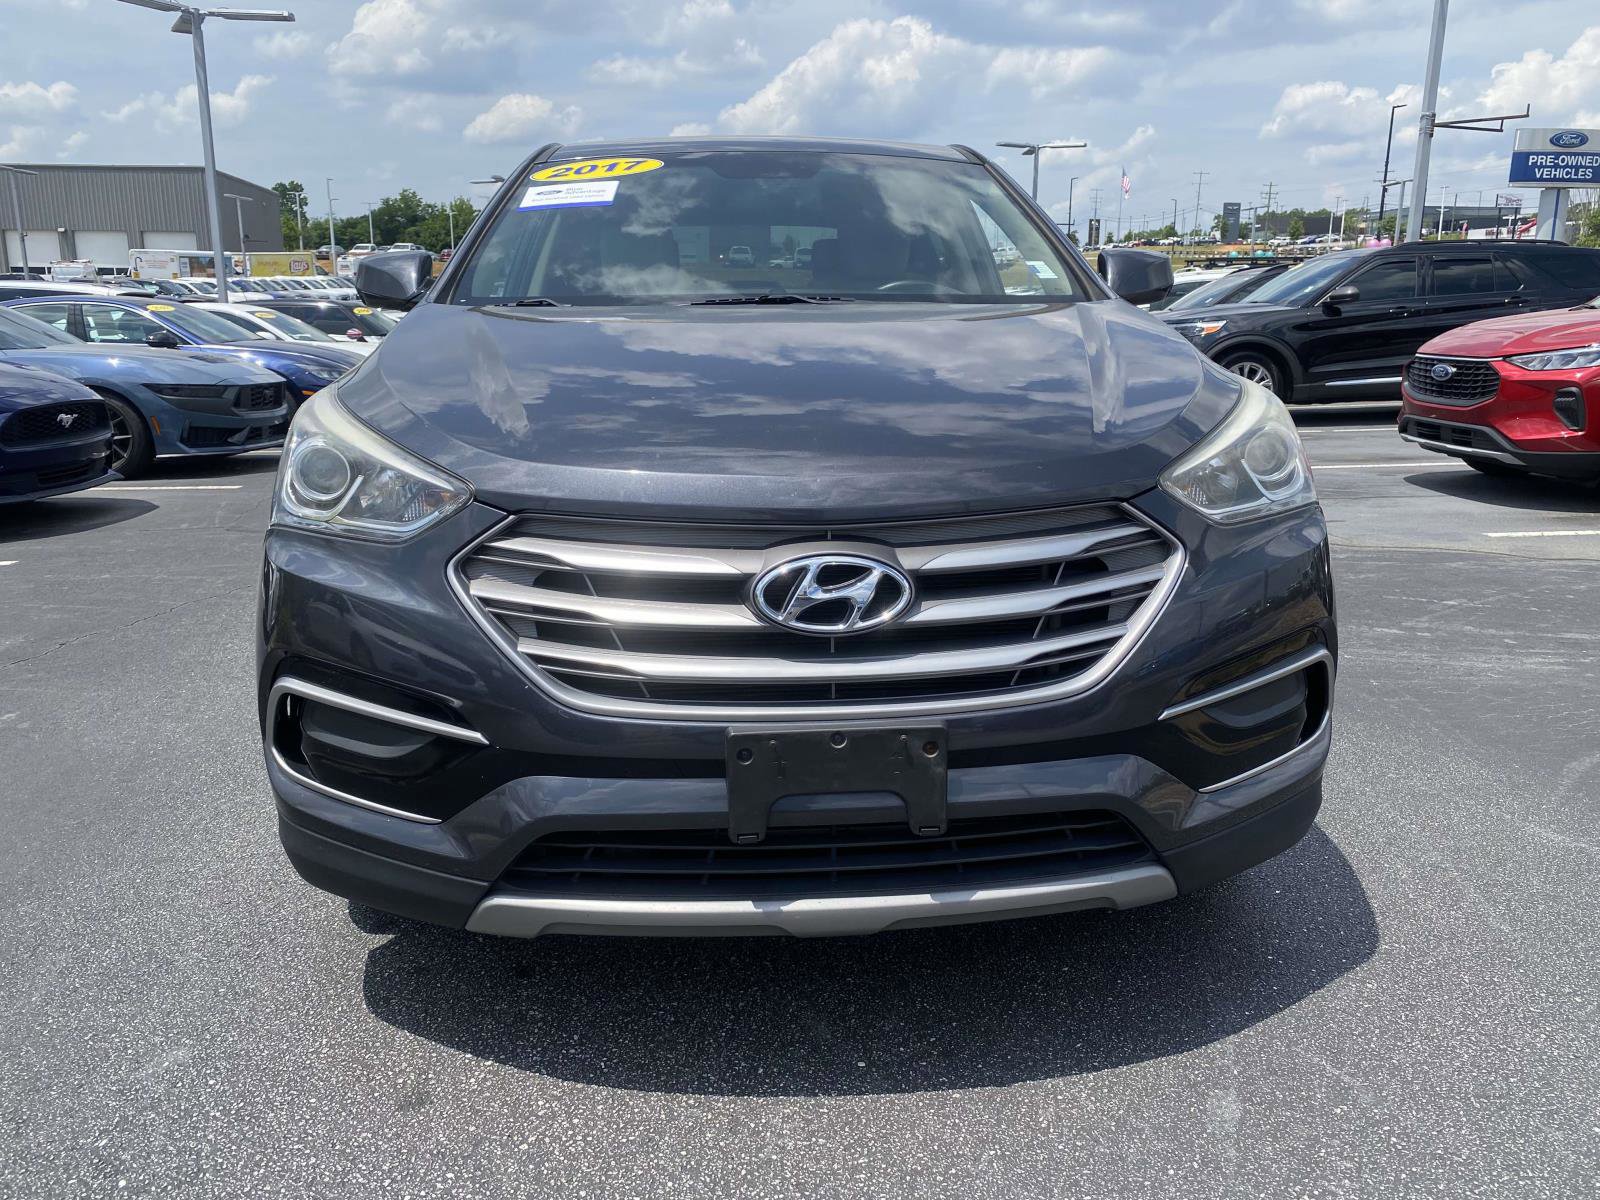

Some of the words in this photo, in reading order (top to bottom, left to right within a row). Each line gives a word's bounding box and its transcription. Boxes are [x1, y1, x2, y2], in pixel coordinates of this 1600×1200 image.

[1559, 134, 1582, 144] Ford
[1528, 155, 1600, 166] PRE-OWNED
[546, 160, 646, 179] 2017
[1535, 168, 1593, 179] VEHICLES
